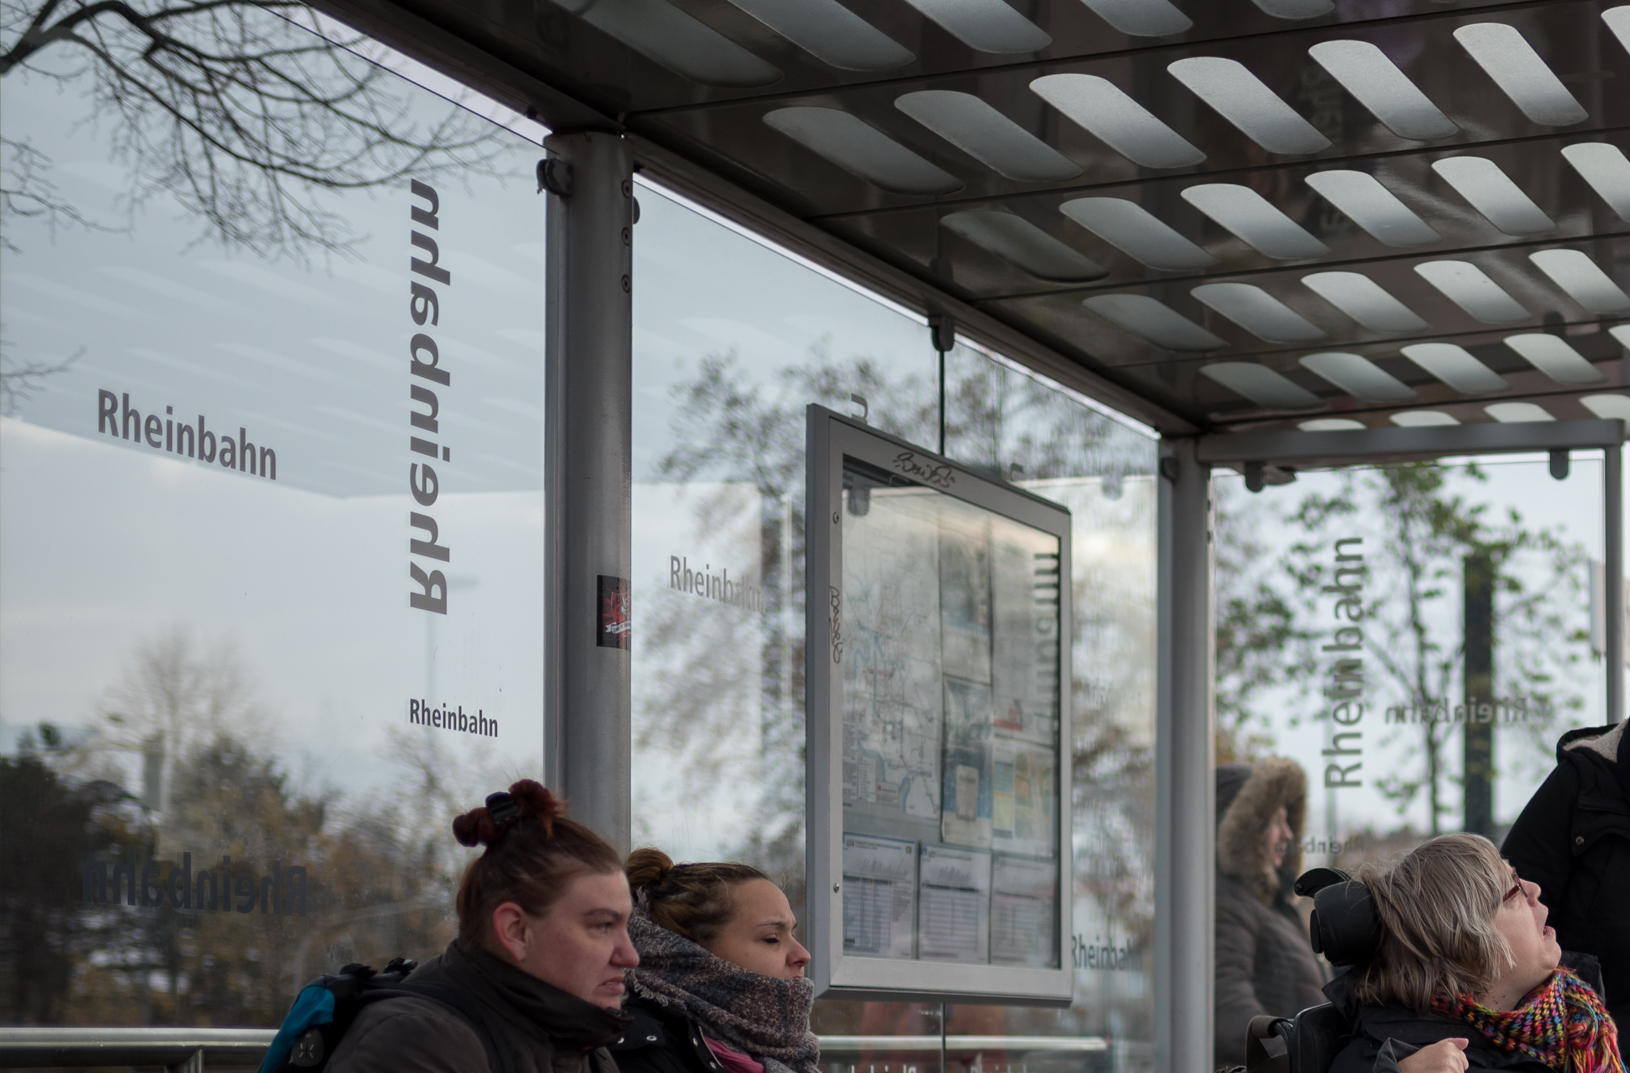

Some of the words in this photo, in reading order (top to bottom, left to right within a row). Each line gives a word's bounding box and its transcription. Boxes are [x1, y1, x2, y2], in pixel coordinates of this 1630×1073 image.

[97, 389, 278, 481] Rheinbahn
[1319, 536, 1364, 788] Rheinbahn
[408, 698, 500, 739] Rheinbahn
